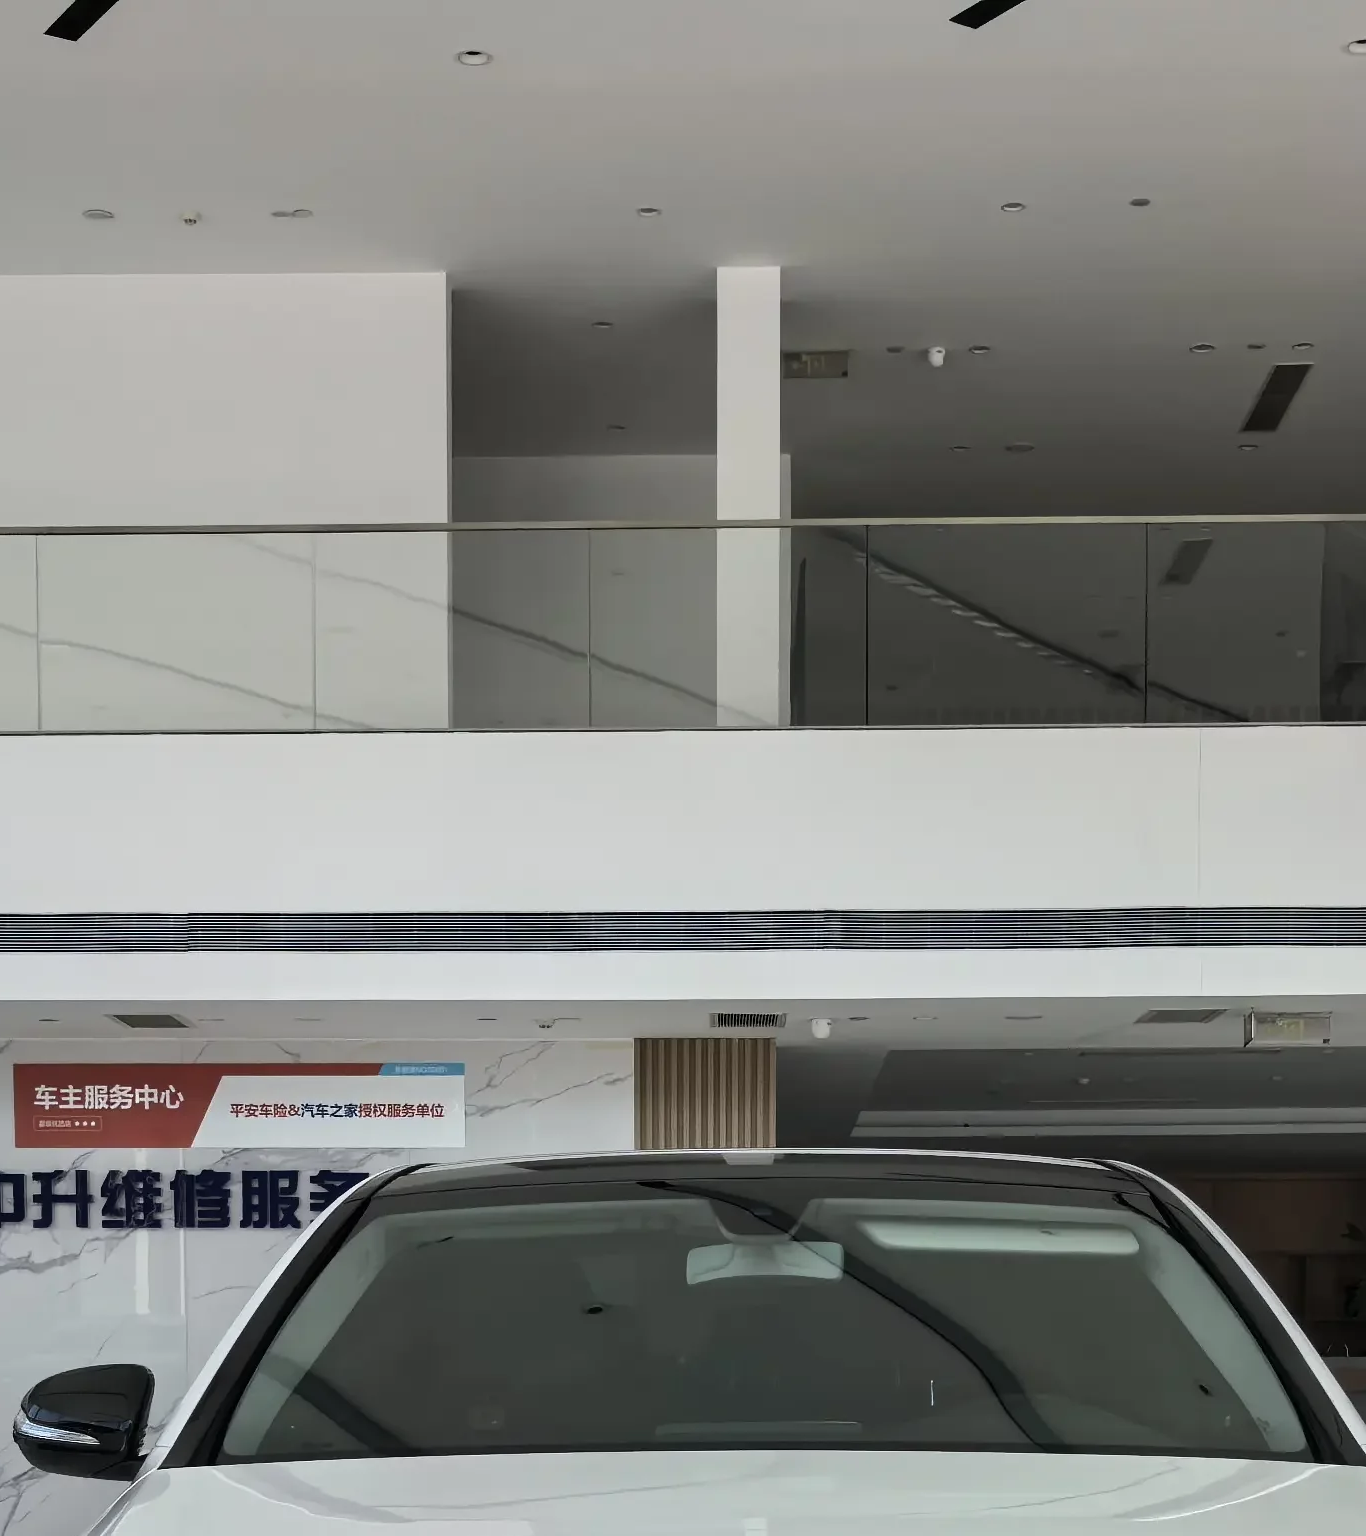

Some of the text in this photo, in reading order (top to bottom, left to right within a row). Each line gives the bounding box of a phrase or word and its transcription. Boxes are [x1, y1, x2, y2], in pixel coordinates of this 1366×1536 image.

[33, 1083, 185, 1110] 车主服务中心
[229, 1102, 445, 1119] 平安车险&汽车之家授权服务单位
